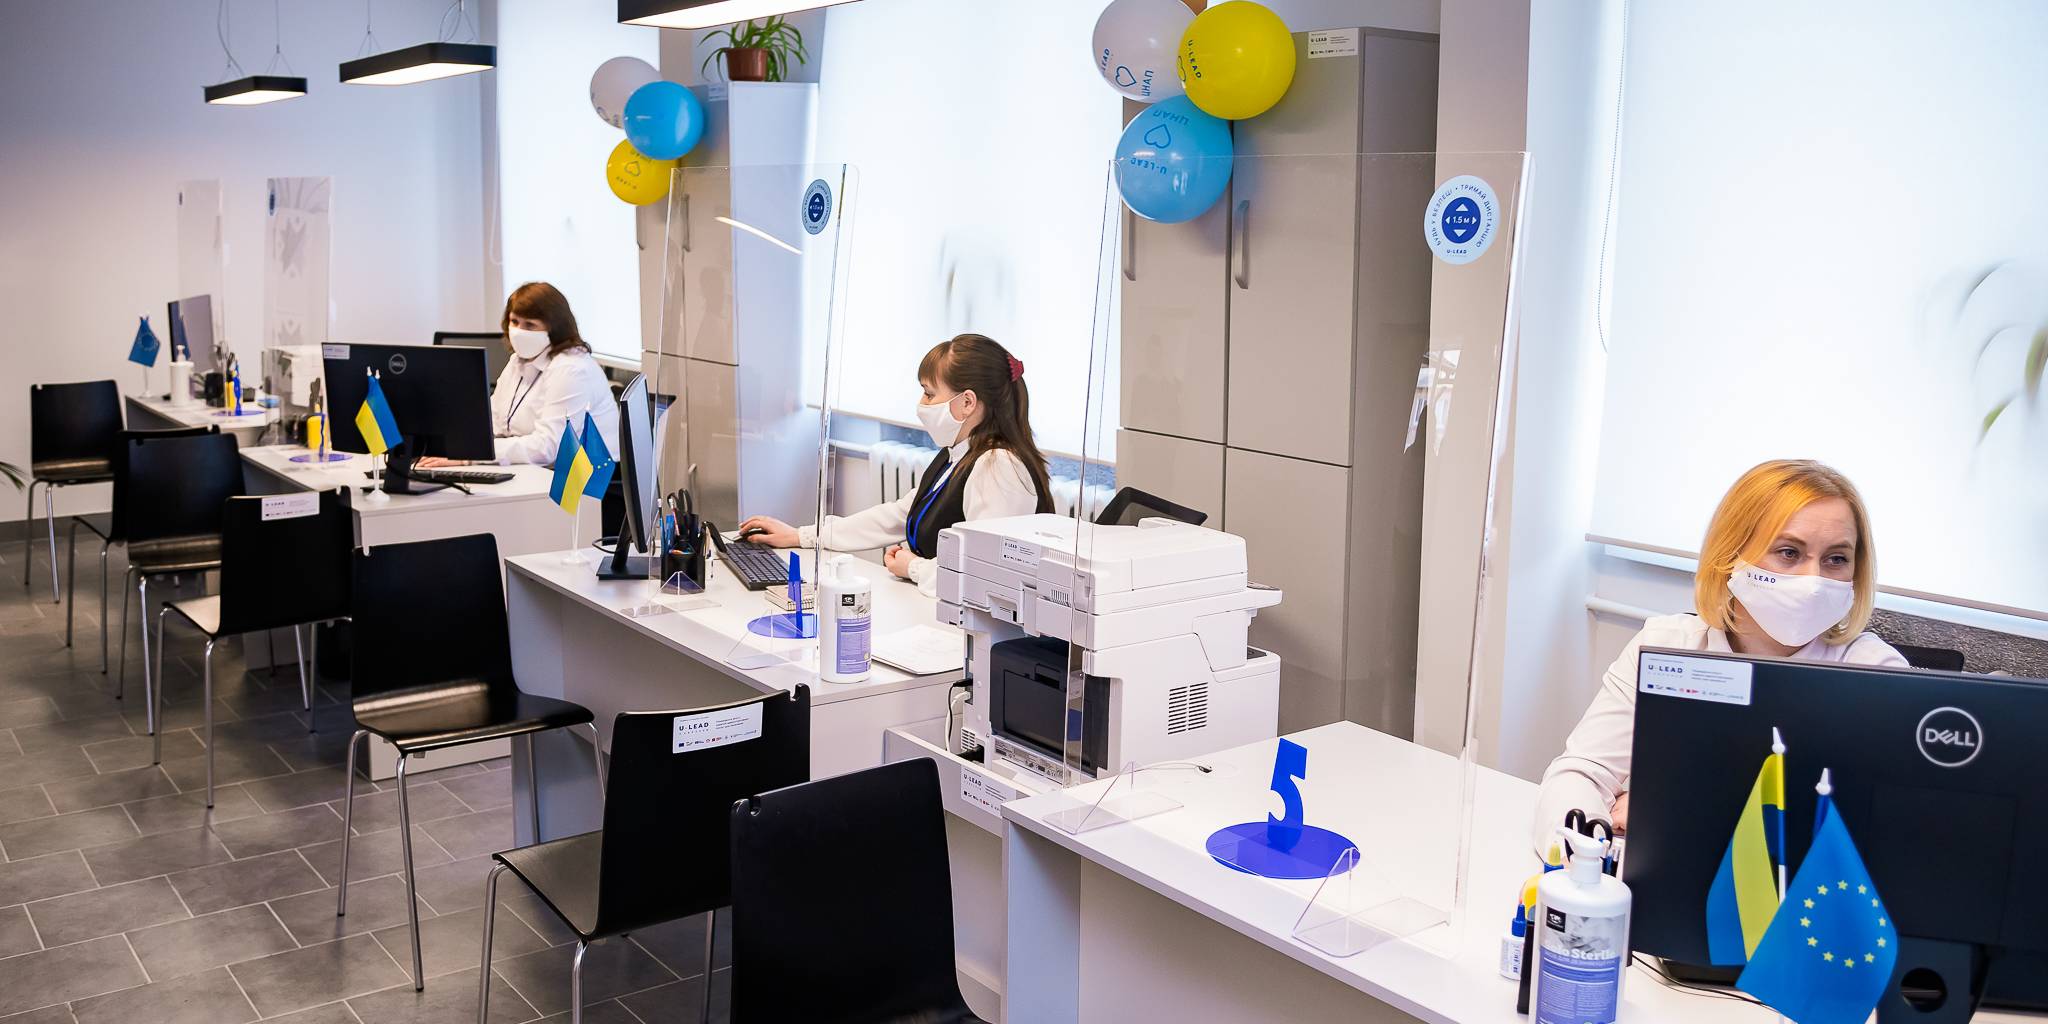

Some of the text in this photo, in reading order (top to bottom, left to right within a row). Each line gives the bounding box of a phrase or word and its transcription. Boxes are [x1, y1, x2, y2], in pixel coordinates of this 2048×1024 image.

[1187, 39, 1202, 79] U-LEAD
[1141, 69, 1154, 97] ЦНАП
[1153, 108, 1190, 126] ЦНАП
[1130, 157, 1167, 175] U-LEAD
[1452, 216, 1463, 224] 1.5
[1924, 727, 1975, 747] DELL
[1268, 738, 1307, 851] 5
